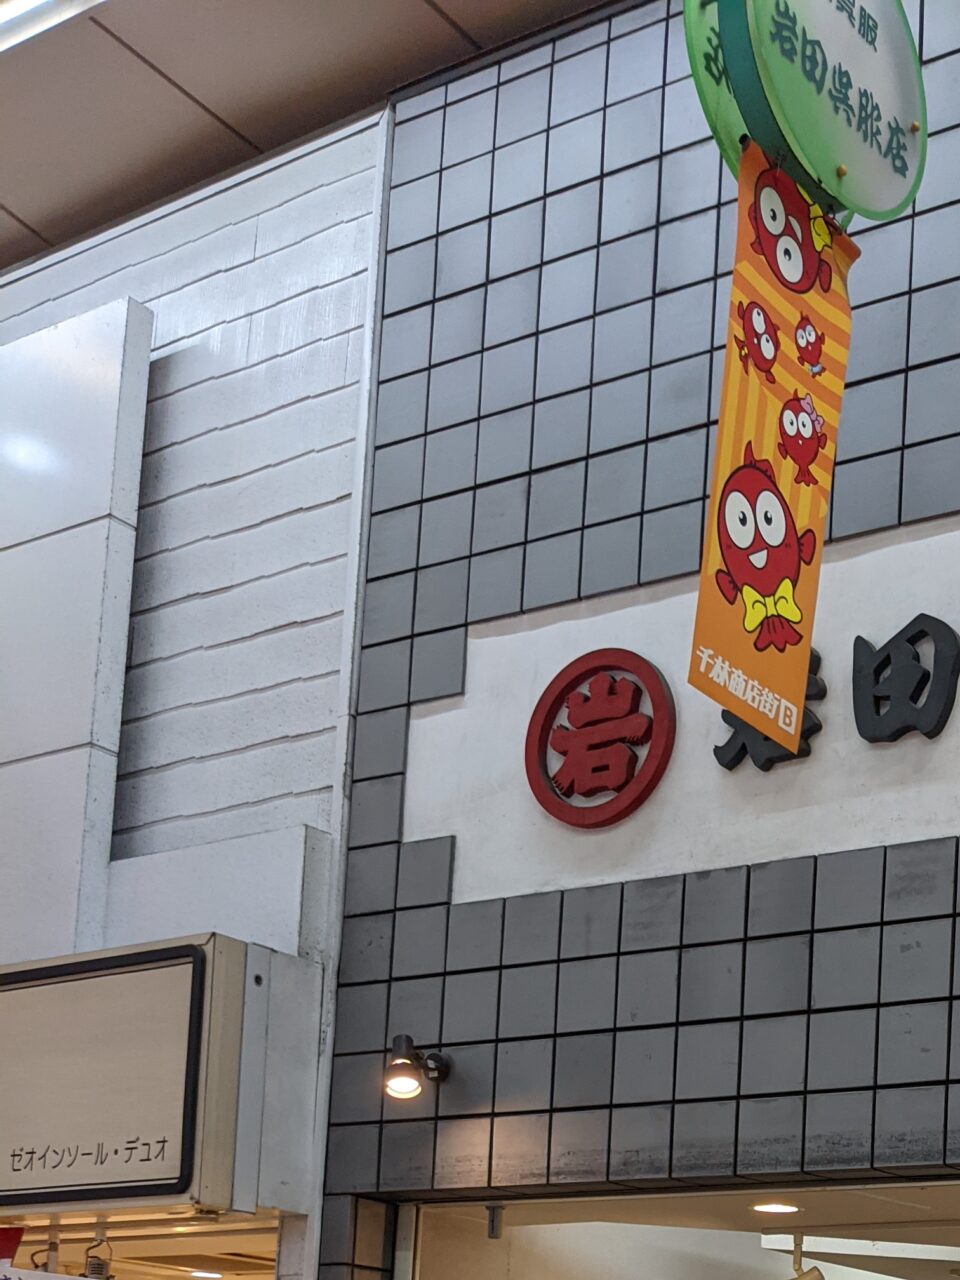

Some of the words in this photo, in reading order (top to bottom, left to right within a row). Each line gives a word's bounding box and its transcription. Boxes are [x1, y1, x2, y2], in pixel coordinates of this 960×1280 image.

[11, 1136, 168, 1172] ゼオインソール・デュオ
